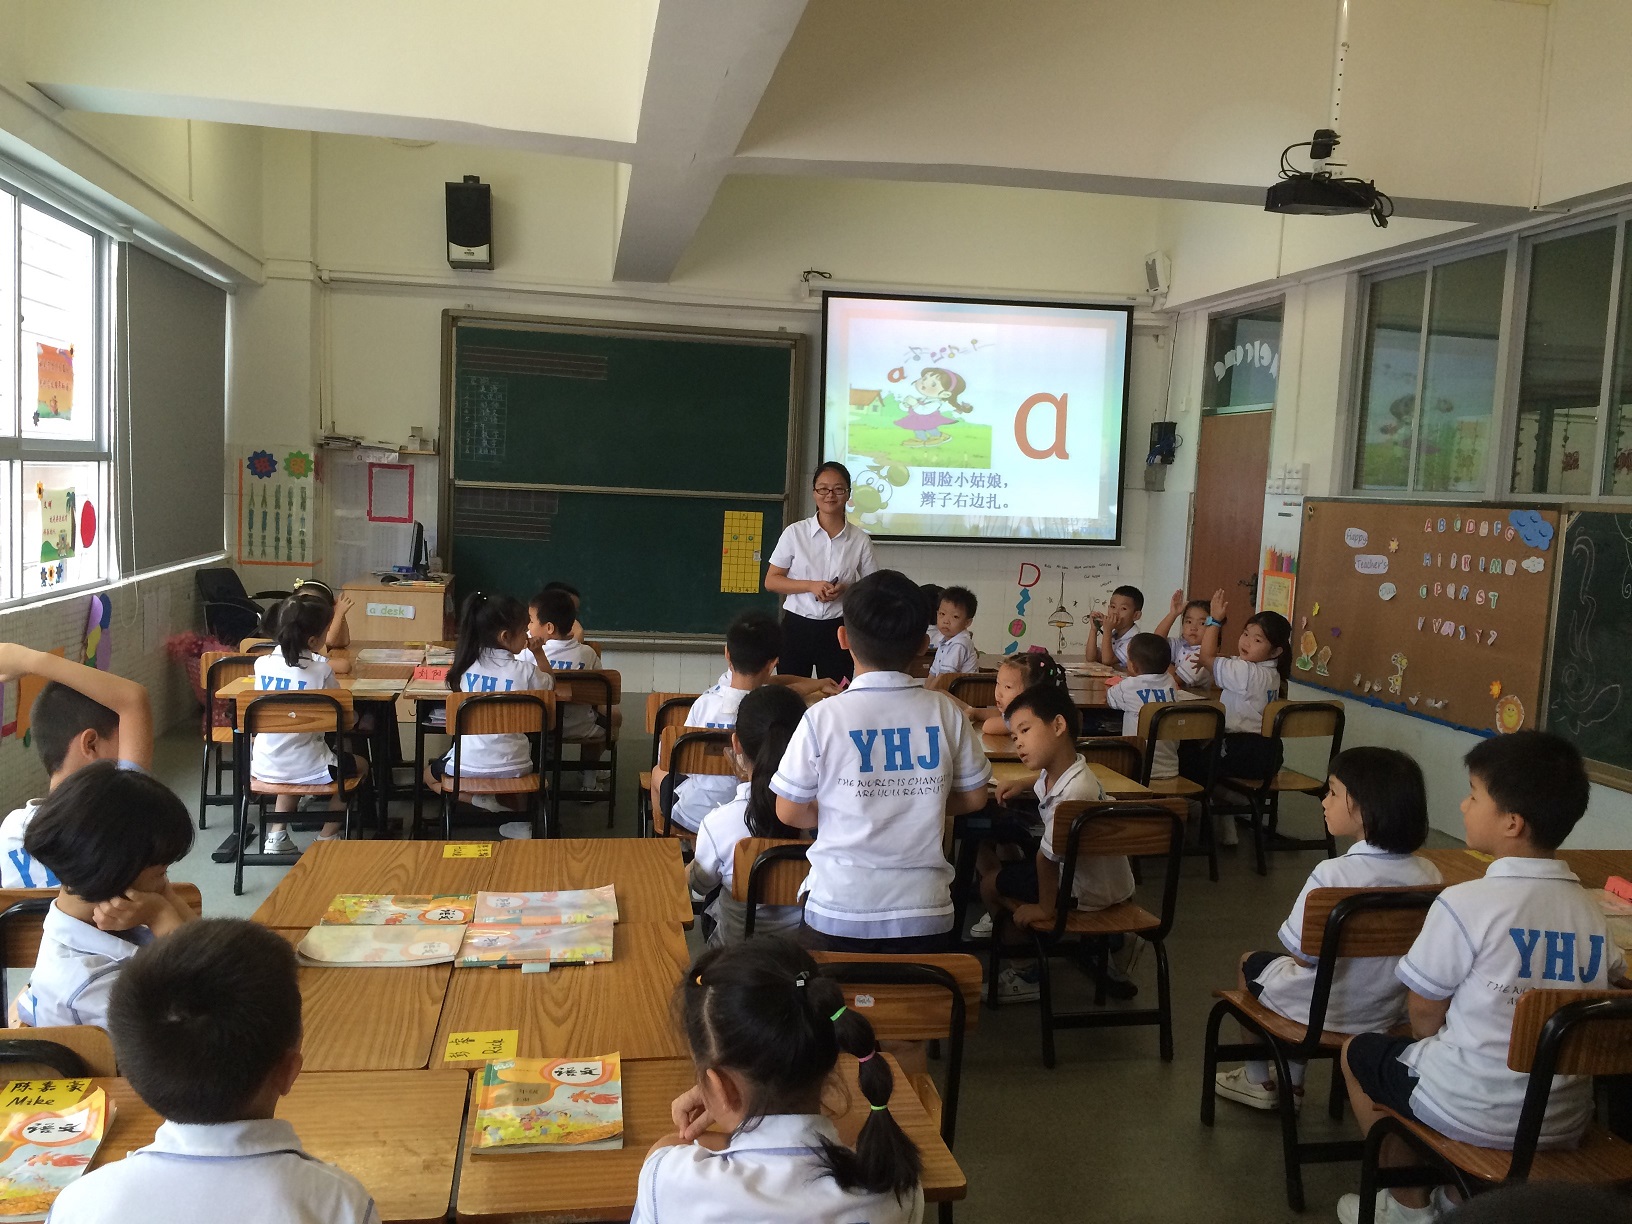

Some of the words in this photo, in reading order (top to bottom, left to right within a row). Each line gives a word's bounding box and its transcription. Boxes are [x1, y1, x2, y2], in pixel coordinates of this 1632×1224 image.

[1014, 392, 1070, 460] a
[1346, 531, 1367, 545] Happy
[1357, 559, 1387, 569] Teacher's
[381, 606, 404, 616] desk
[849, 726, 940, 772] YHJ
[837, 778, 854, 787] THE
[857, 777, 894, 788] WORLD
[897, 777, 905, 787] IS
[855, 789, 875, 798] ARE
[878, 787, 899, 798] YOU
[1509, 928, 1604, 983] YHJ
[554, 1067, 601, 1077] 语文
[6, 1095, 55, 1107] Mike
[27, 1122, 81, 1133] 语文
